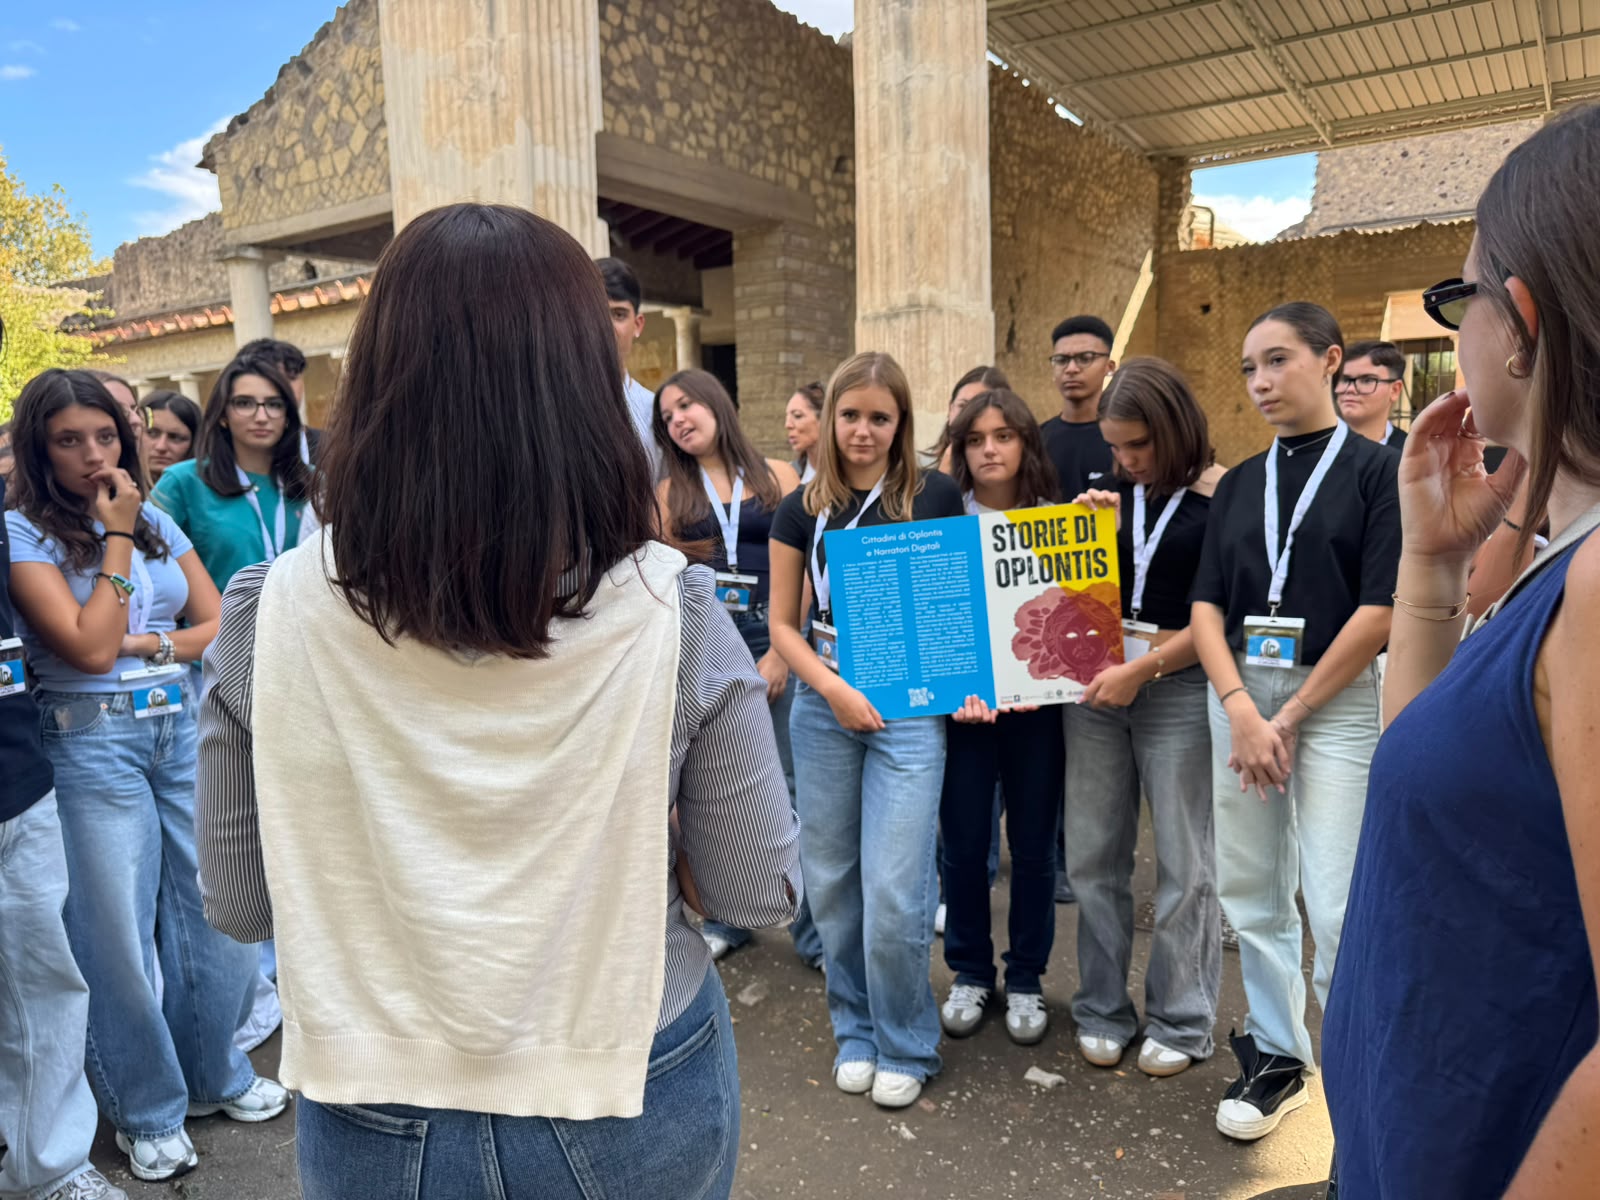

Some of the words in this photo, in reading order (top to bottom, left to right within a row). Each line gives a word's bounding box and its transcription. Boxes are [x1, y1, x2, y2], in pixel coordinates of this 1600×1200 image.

[861, 534, 897, 544] Cittadini
[898, 532, 907, 541] di
[908, 529, 943, 540] Oplontis
[991, 517, 1068, 553] STORIE
[1074, 514, 1097, 544] DI
[873, 545, 910, 556] Narratori
[911, 541, 941, 553] Digitali
[995, 548, 1108, 588] OPLONTIS
